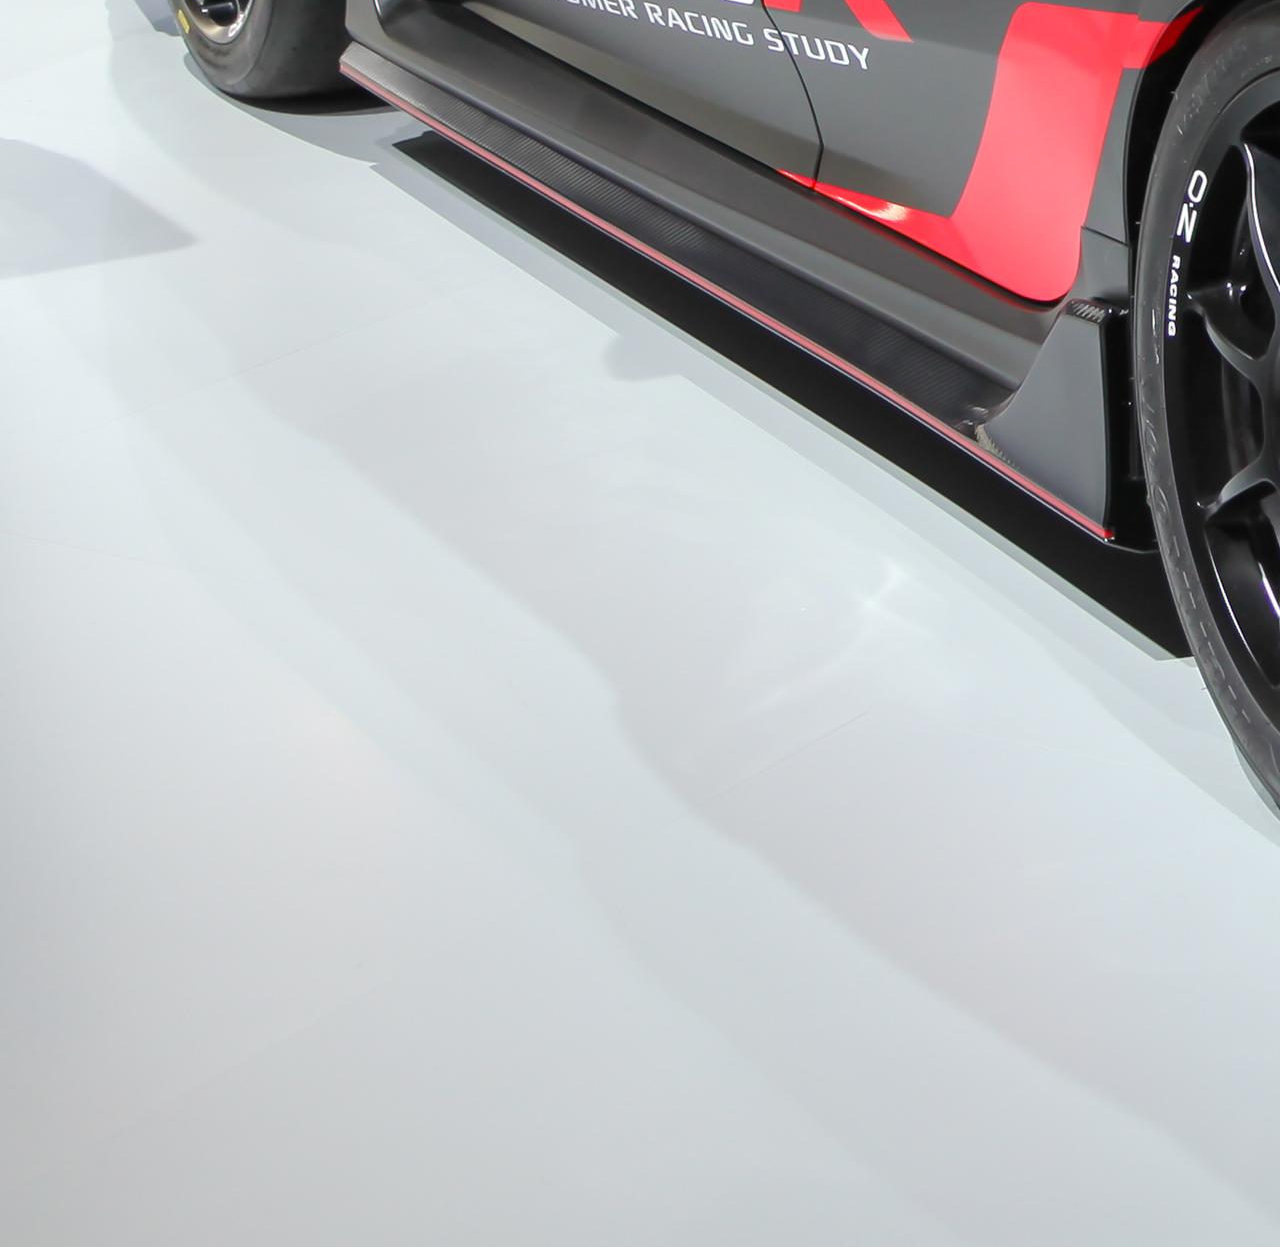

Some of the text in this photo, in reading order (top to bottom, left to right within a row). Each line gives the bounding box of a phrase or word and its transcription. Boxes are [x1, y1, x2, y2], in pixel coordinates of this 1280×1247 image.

[643, 1, 755, 47] RACING
[763, 26, 871, 71] STUDY
[1166, 254, 1181, 337] RACING
